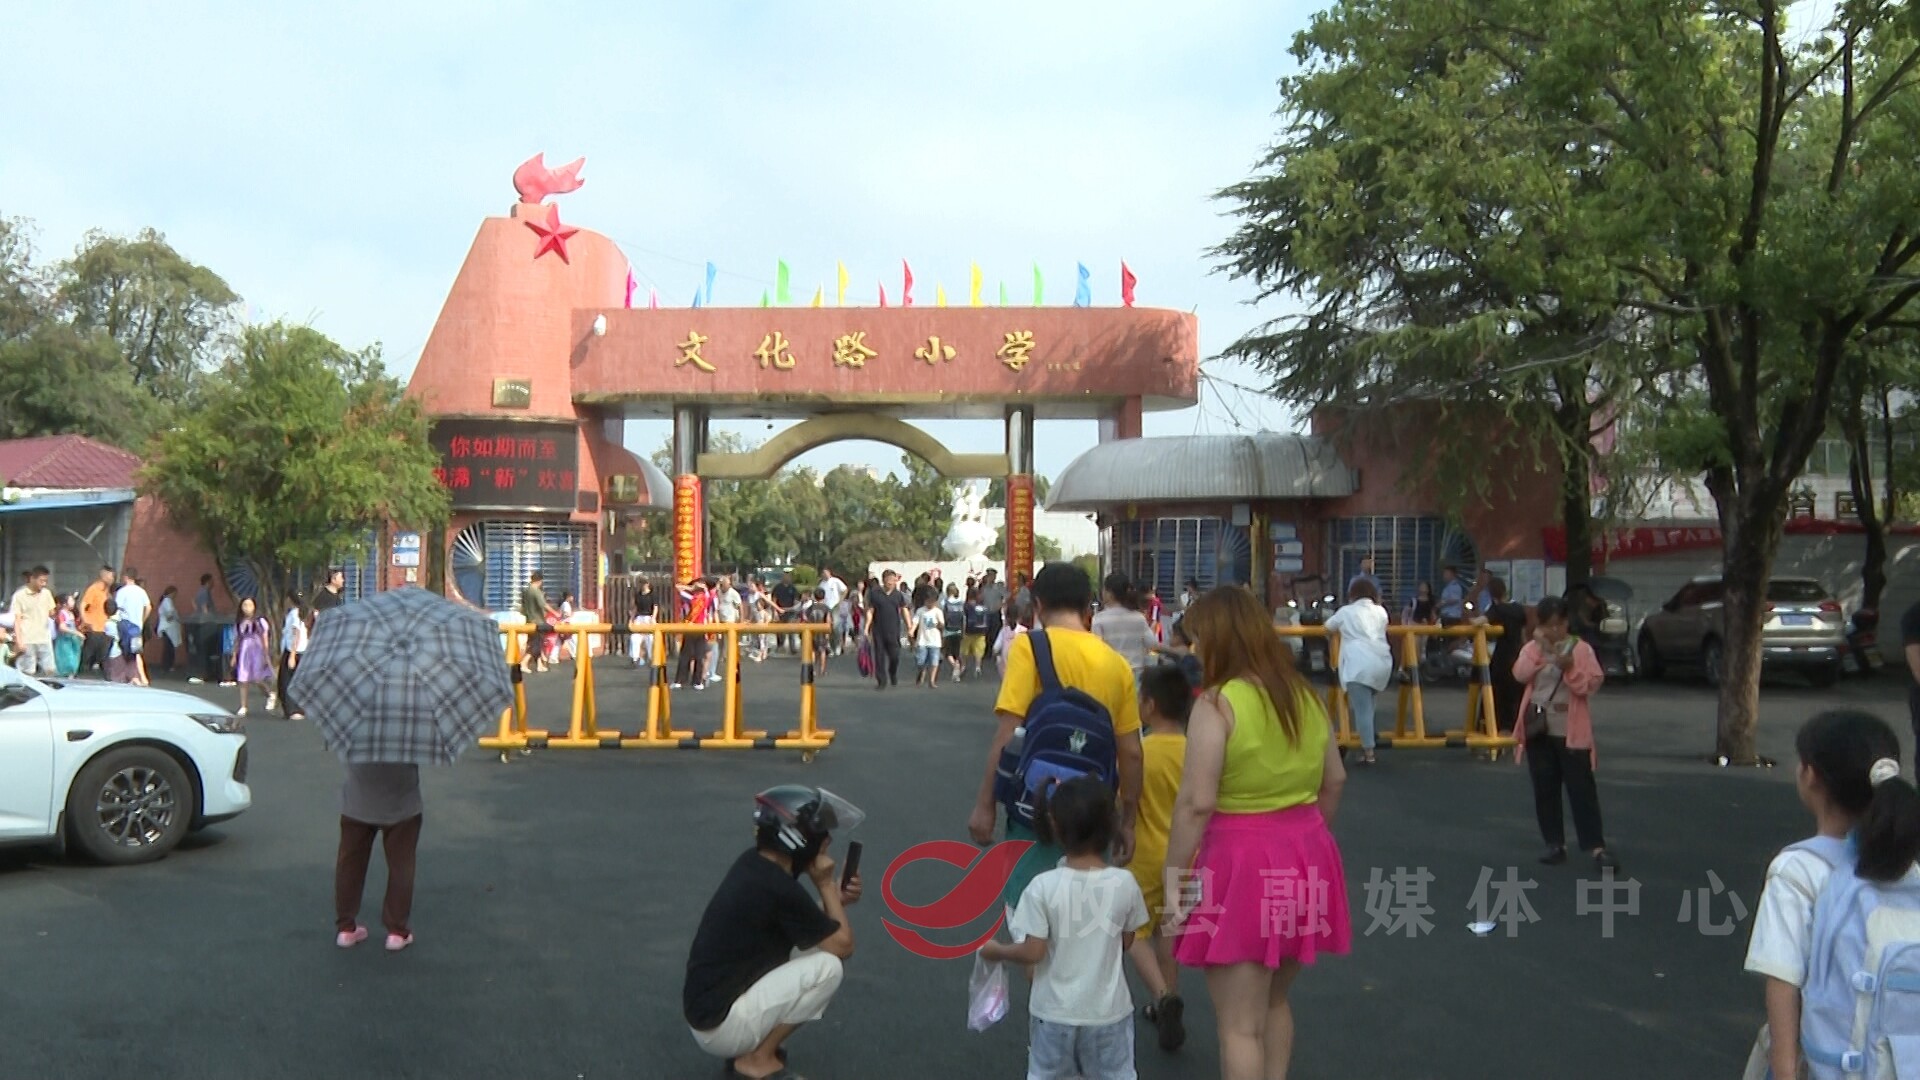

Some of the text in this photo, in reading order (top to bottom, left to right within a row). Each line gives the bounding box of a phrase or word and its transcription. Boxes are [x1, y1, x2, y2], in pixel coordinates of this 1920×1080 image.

[674, 330, 1036, 373] 文化路小学
[450, 434, 557, 460] 你如期而至
